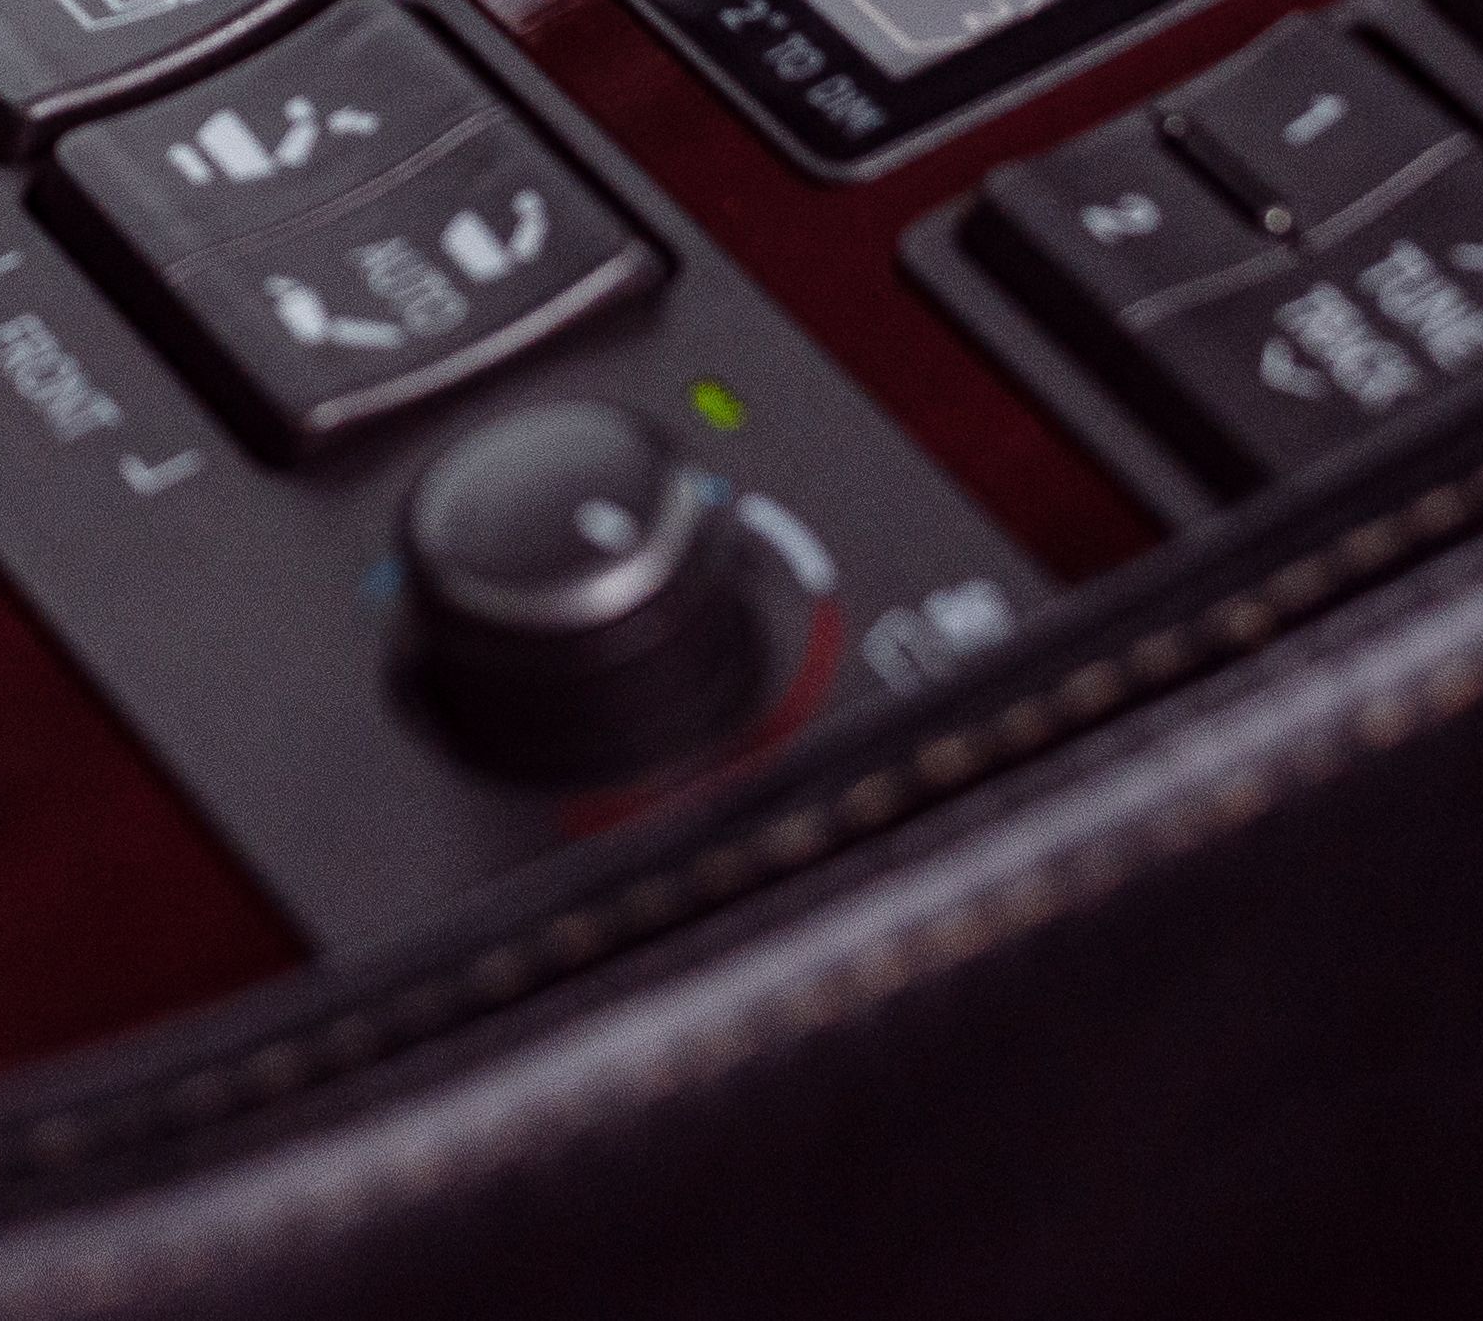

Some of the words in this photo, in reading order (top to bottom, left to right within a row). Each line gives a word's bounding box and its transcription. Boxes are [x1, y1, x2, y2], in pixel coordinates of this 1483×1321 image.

[761, 29, 828, 82] TO
[1281, 92, 1350, 148] 1
[1080, 192, 1163, 244] 2
[350, 233, 471, 337] AUTO
